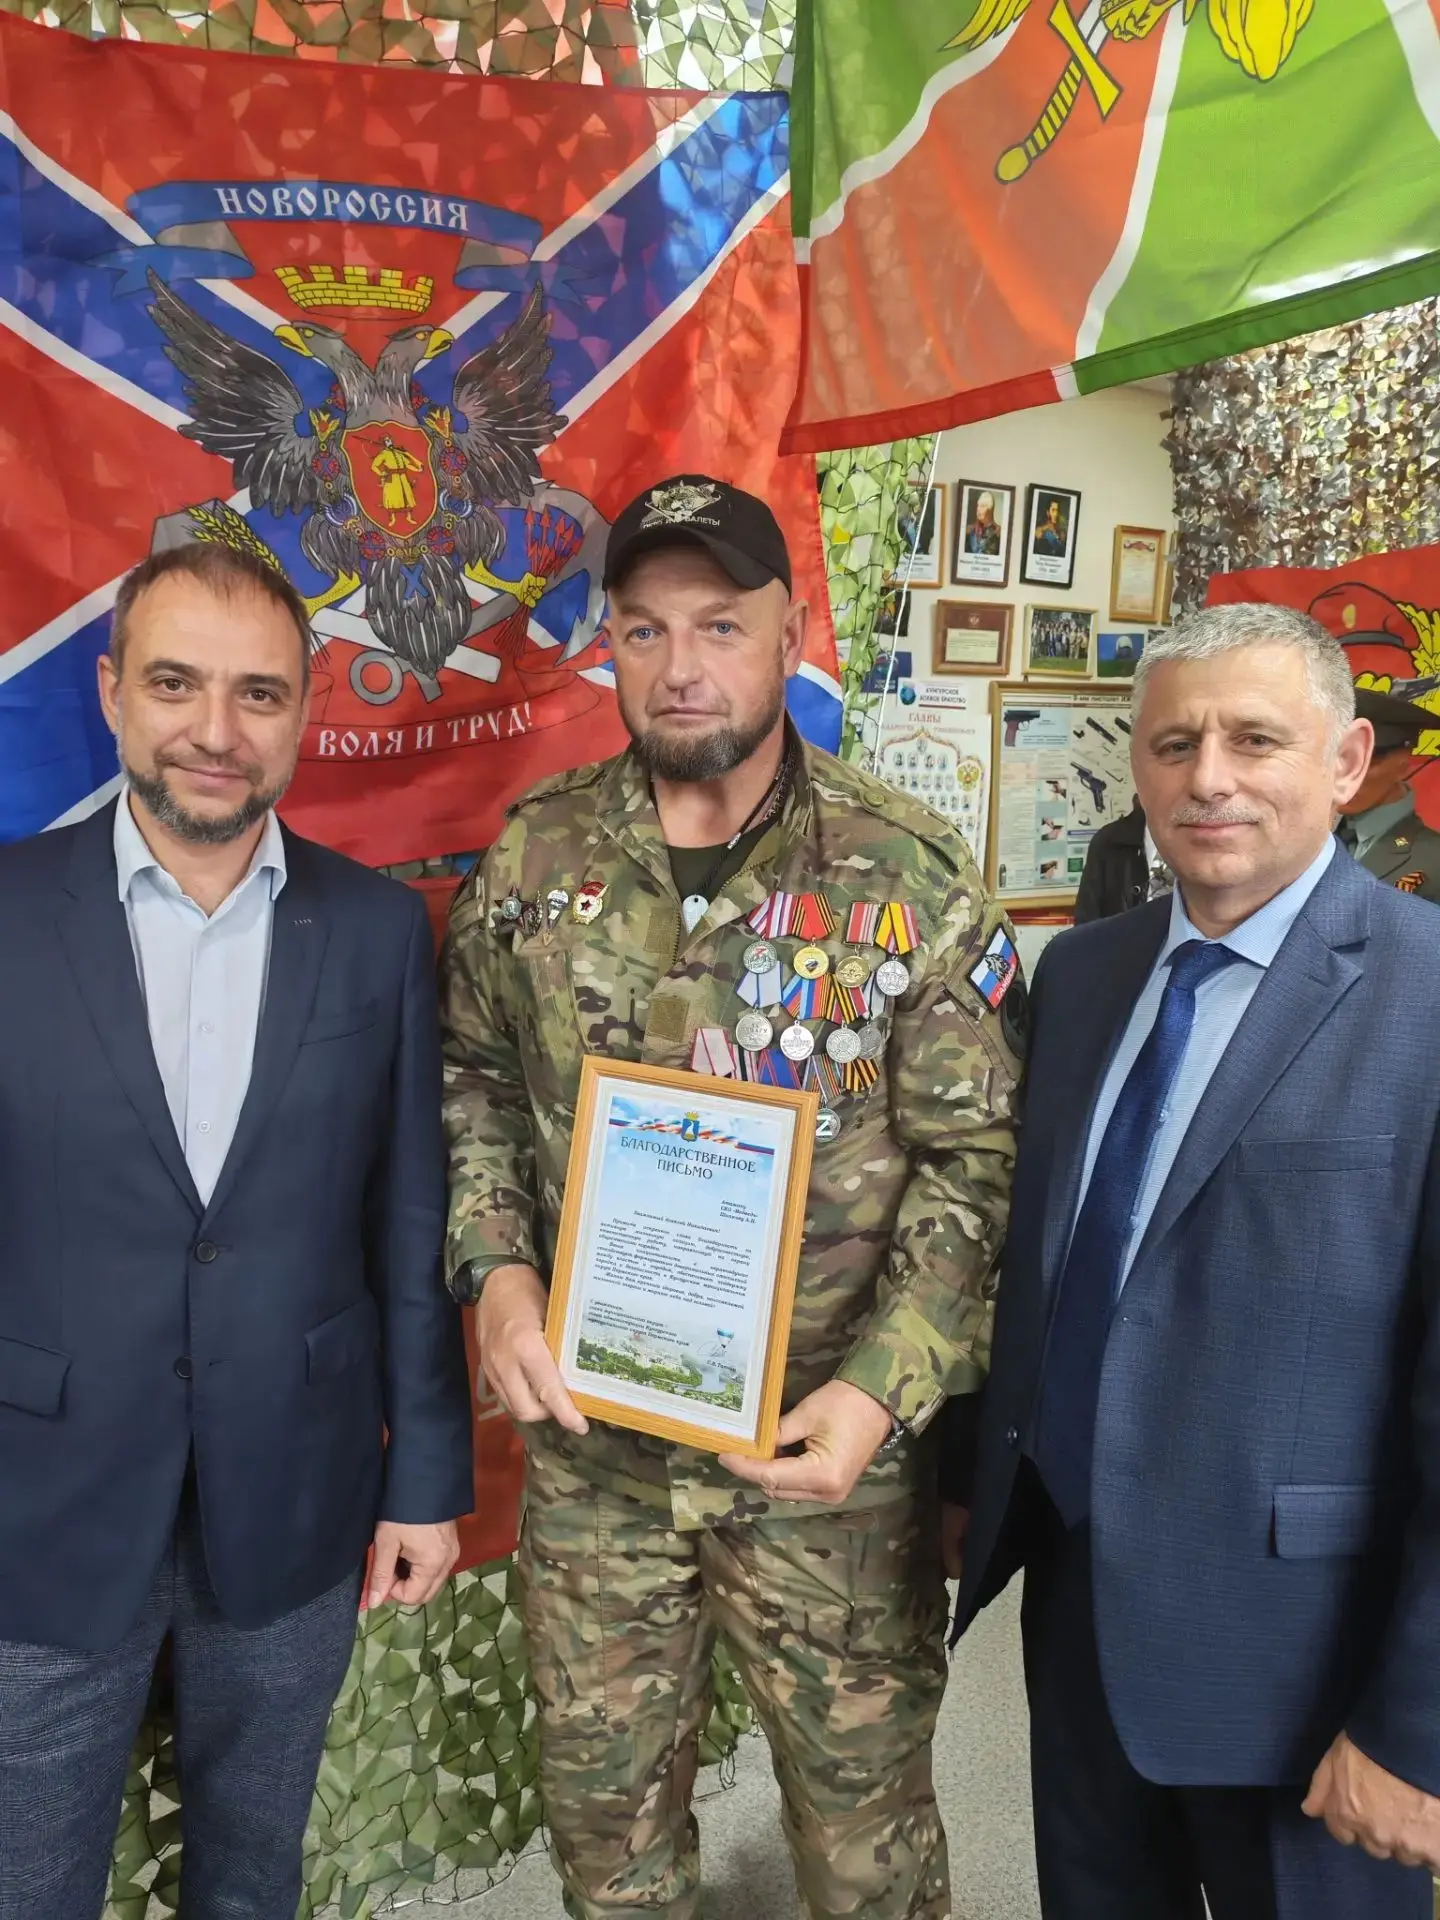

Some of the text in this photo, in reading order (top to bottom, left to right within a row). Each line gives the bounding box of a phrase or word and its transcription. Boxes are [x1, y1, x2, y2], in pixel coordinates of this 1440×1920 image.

[214, 187, 468, 231] НОВОРОССИЯ
[318, 702, 532, 756] ВОЛЯ И ТРУД!
[620, 1136, 757, 1173] БЛАГОДАРСТВЕННОЕ
[657, 1159, 713, 1180] ПИСЬМО
